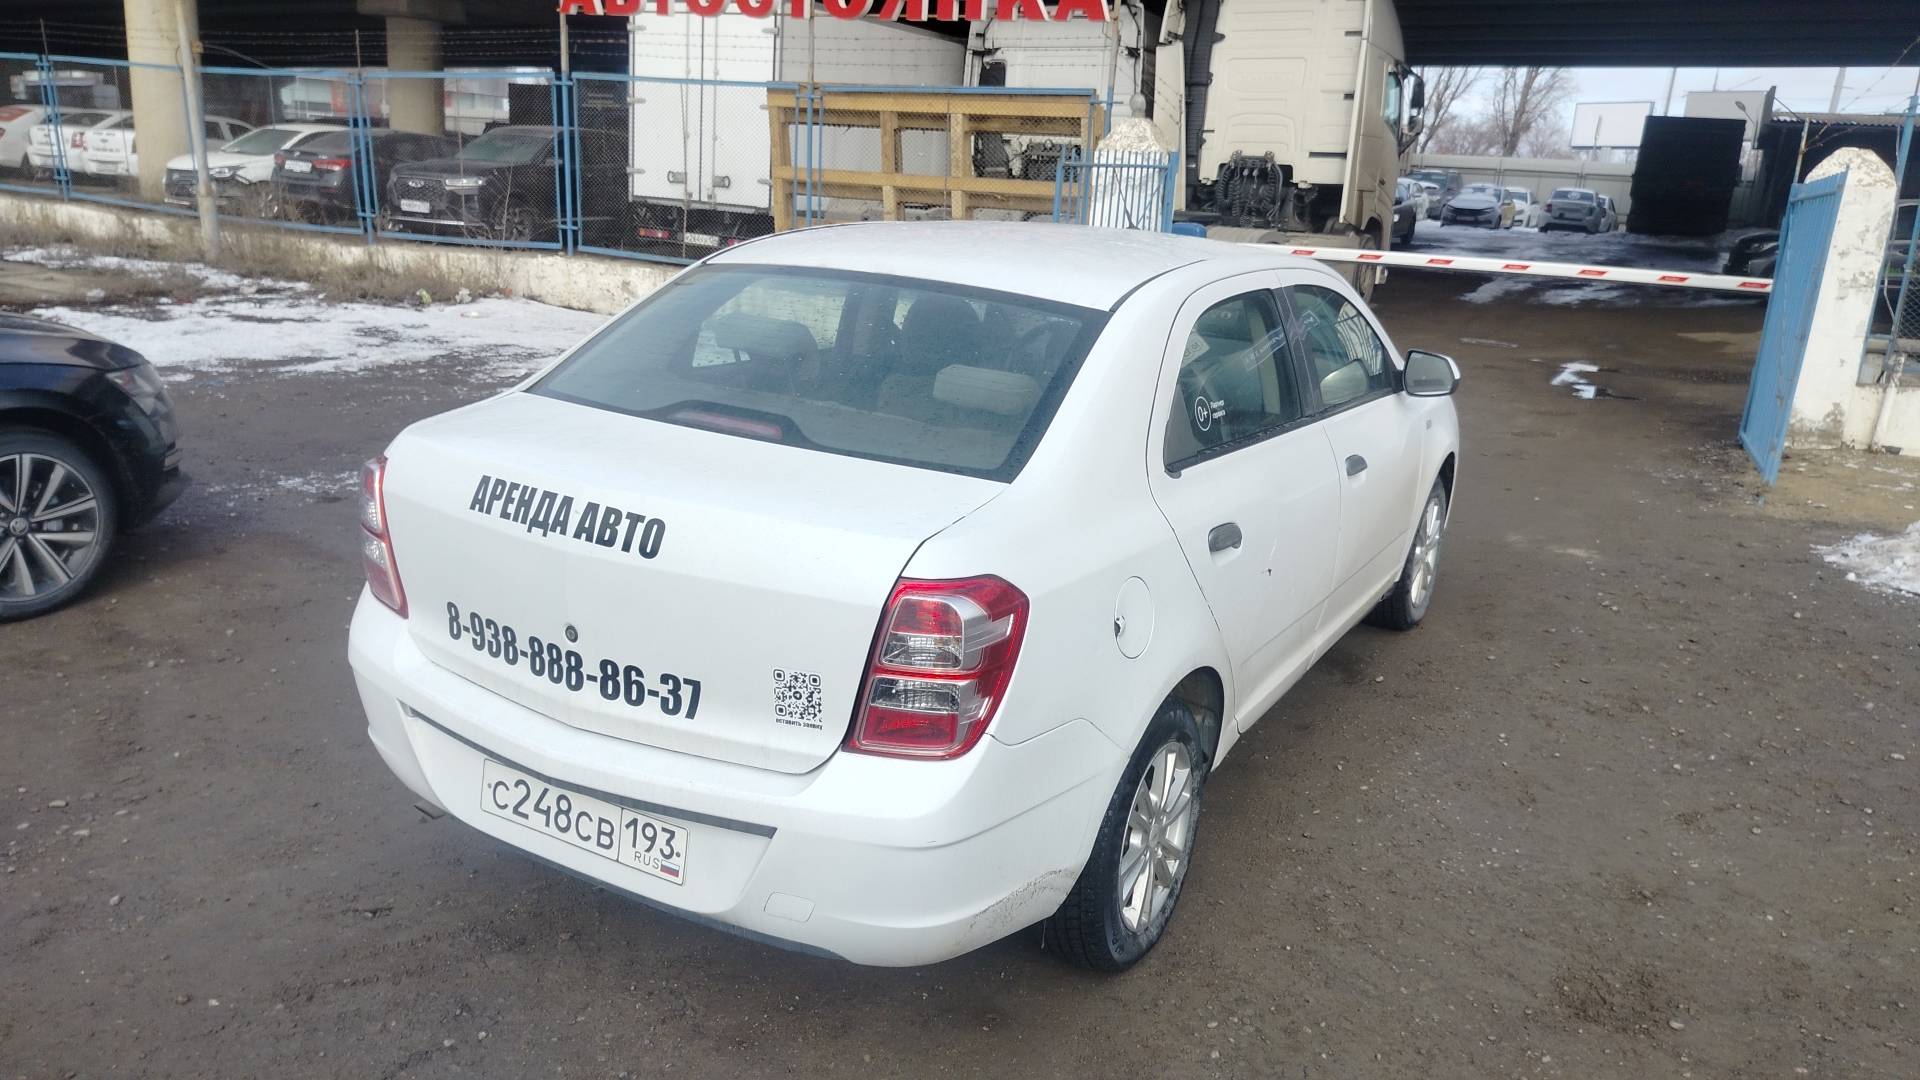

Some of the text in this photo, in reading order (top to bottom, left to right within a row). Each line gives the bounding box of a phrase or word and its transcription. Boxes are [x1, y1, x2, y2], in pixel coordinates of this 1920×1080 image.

[470, 475, 666, 560] АРЕНДА АВТО
[447, 601, 702, 720] 8-938-888-86-37
[492, 779, 676, 860] С248СВ 193
[633, 852, 660, 870] RUS
